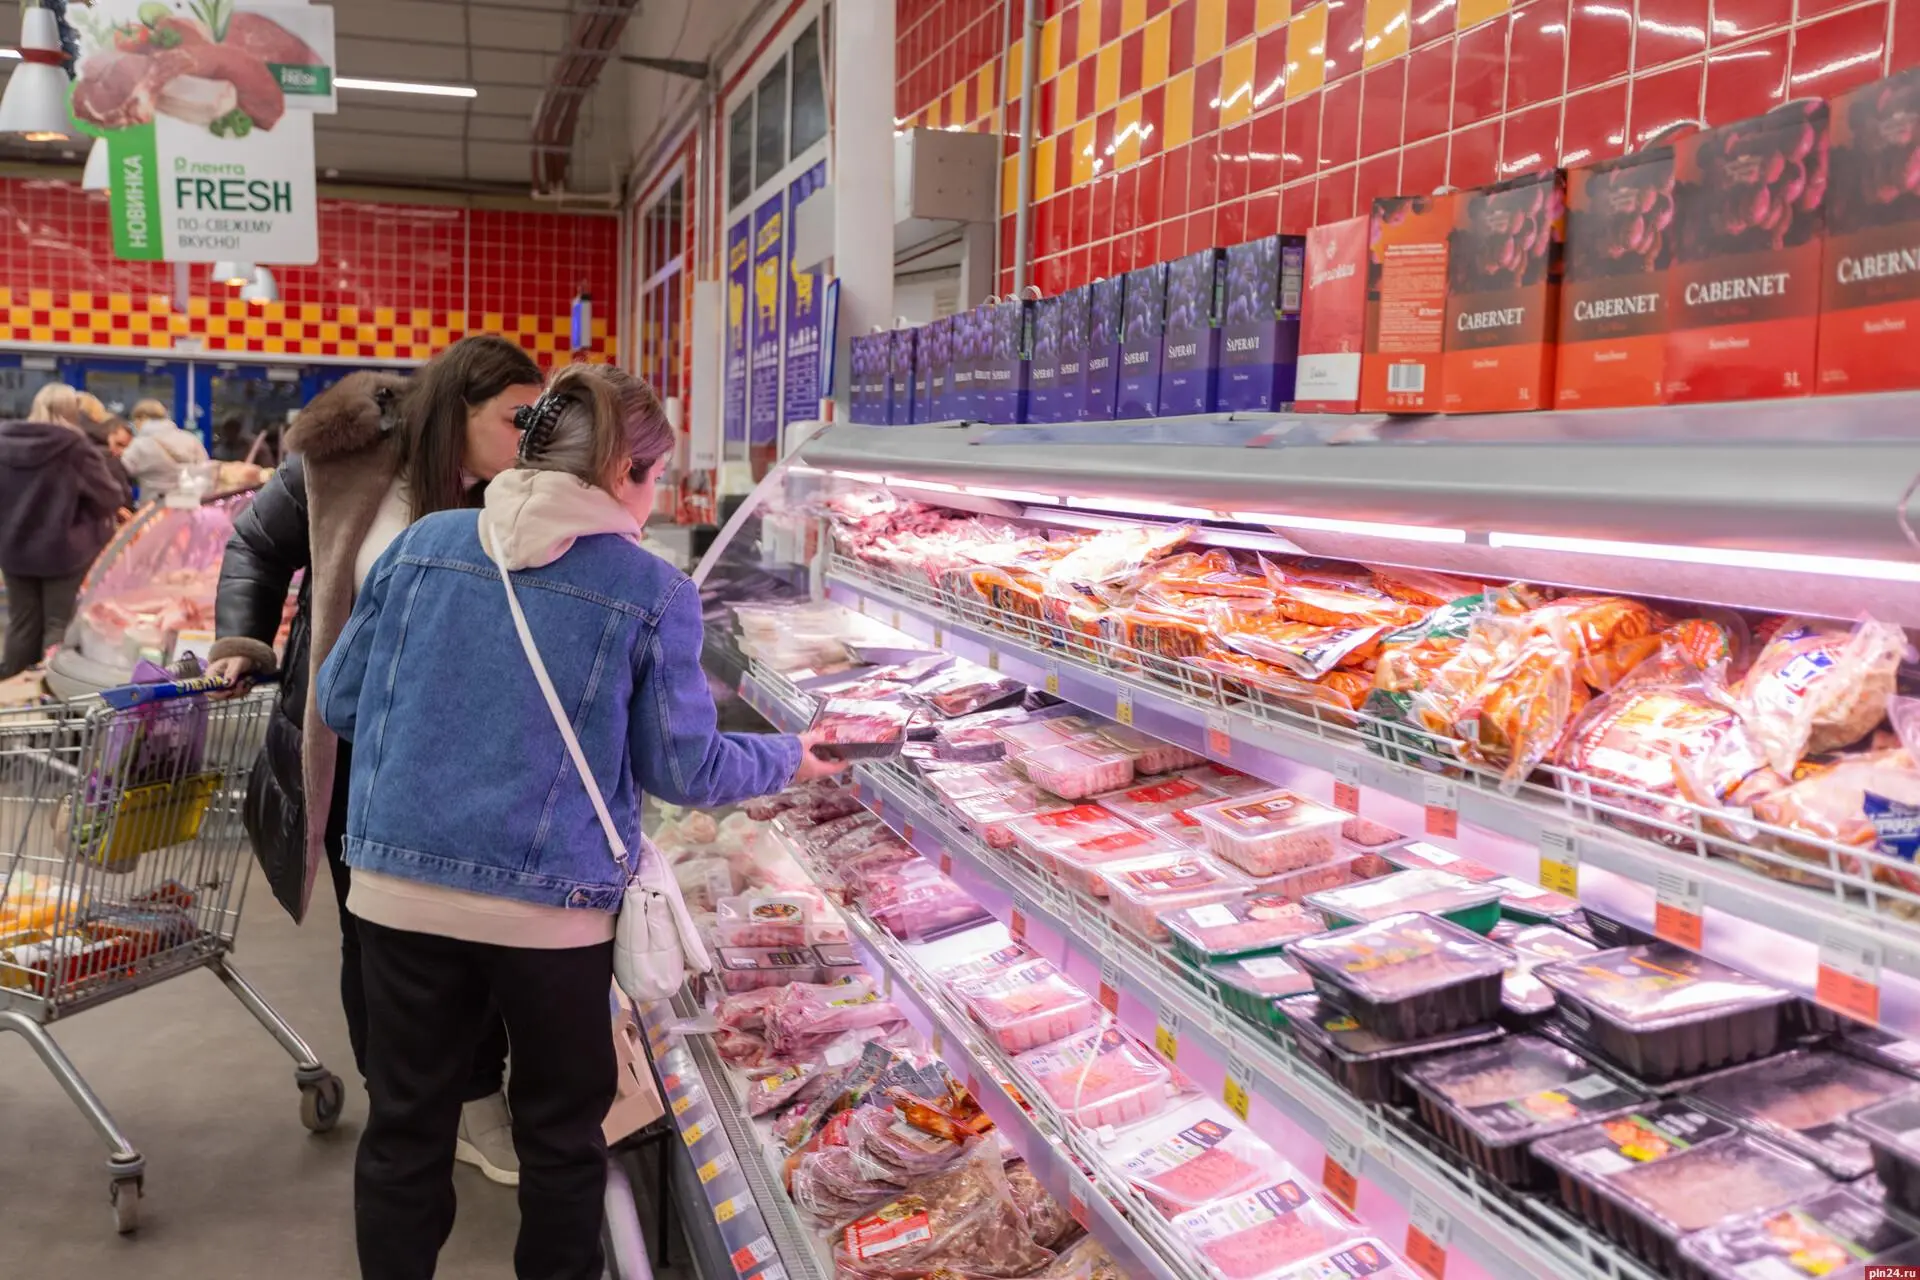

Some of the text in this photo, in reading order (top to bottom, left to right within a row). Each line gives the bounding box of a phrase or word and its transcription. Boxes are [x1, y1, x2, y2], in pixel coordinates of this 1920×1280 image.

[123, 154, 147, 248] НОВИНКА
[176, 177, 292, 214] FRESH
[178, 235, 241, 250] ВКУСНО!
[1684, 272, 1791, 306] CABERNET
[1457, 307, 1526, 332] CABERNET
[1574, 293, 1660, 322] CABERNET
